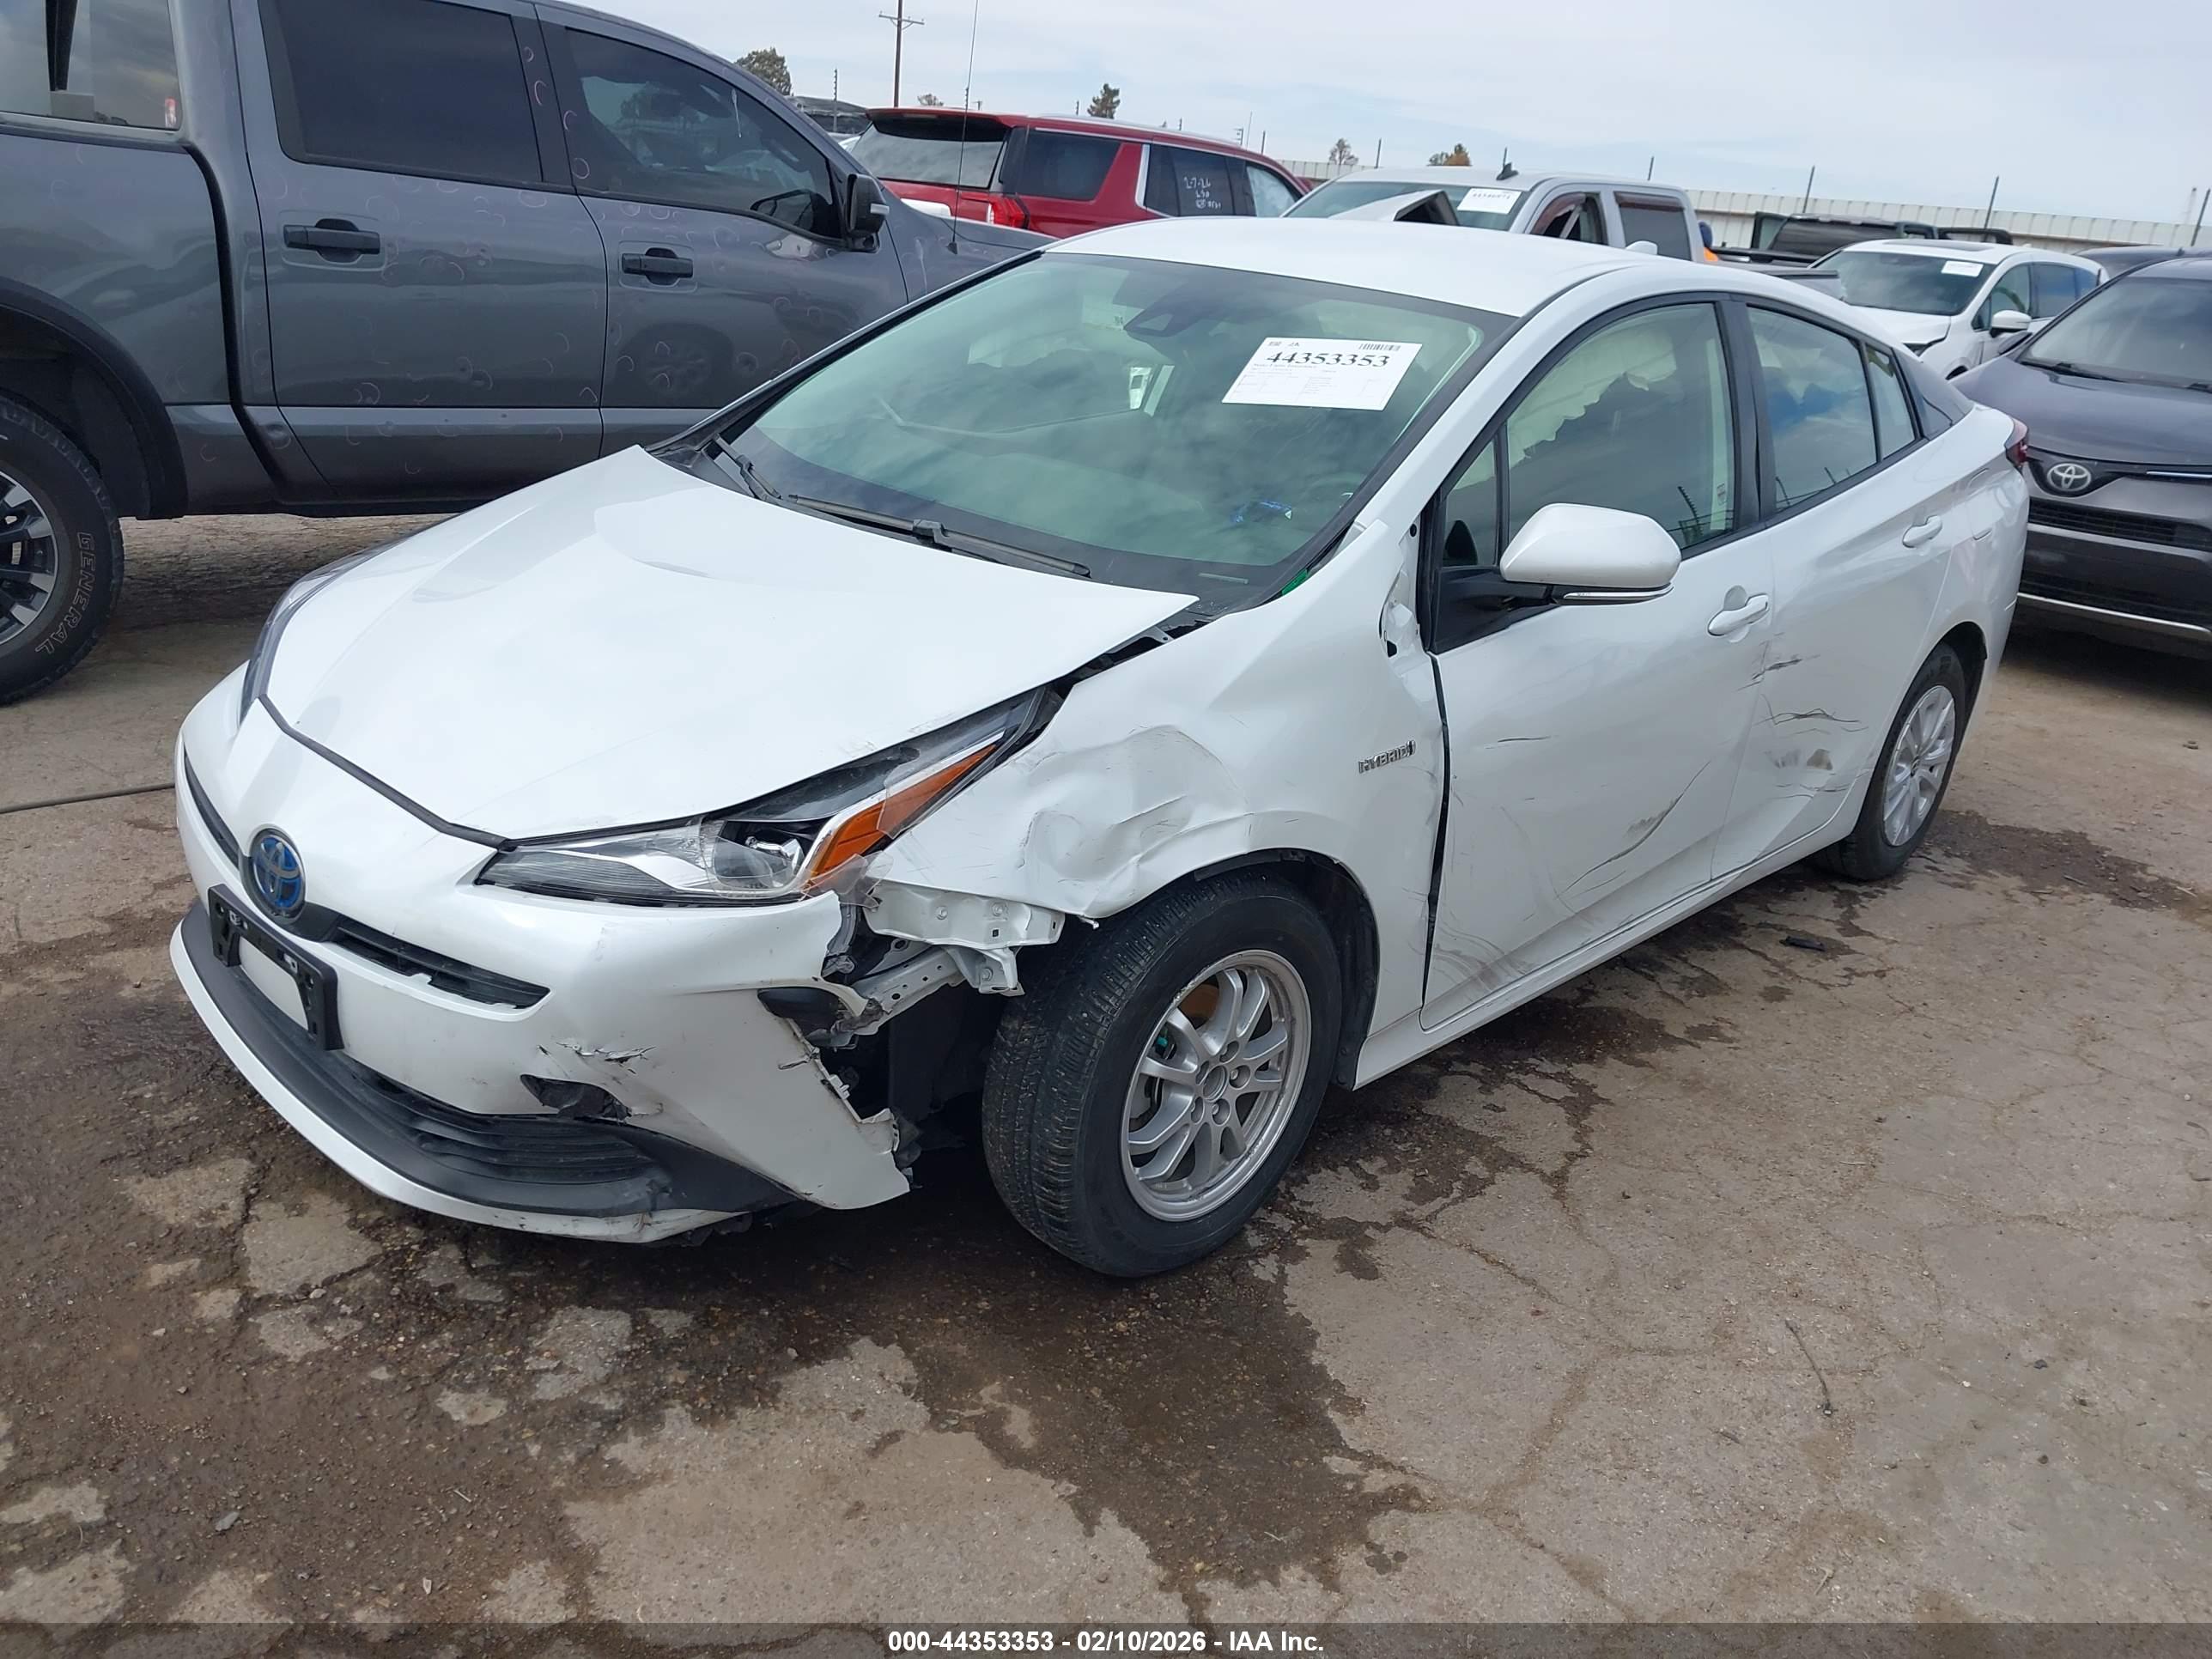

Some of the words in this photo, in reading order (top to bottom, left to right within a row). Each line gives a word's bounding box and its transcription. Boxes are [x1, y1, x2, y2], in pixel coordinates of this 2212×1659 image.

[1267, 351, 1390, 368] 44353353
[34, 532, 96, 654] GENERAL
[1358, 742, 1411, 774] HYBRID
